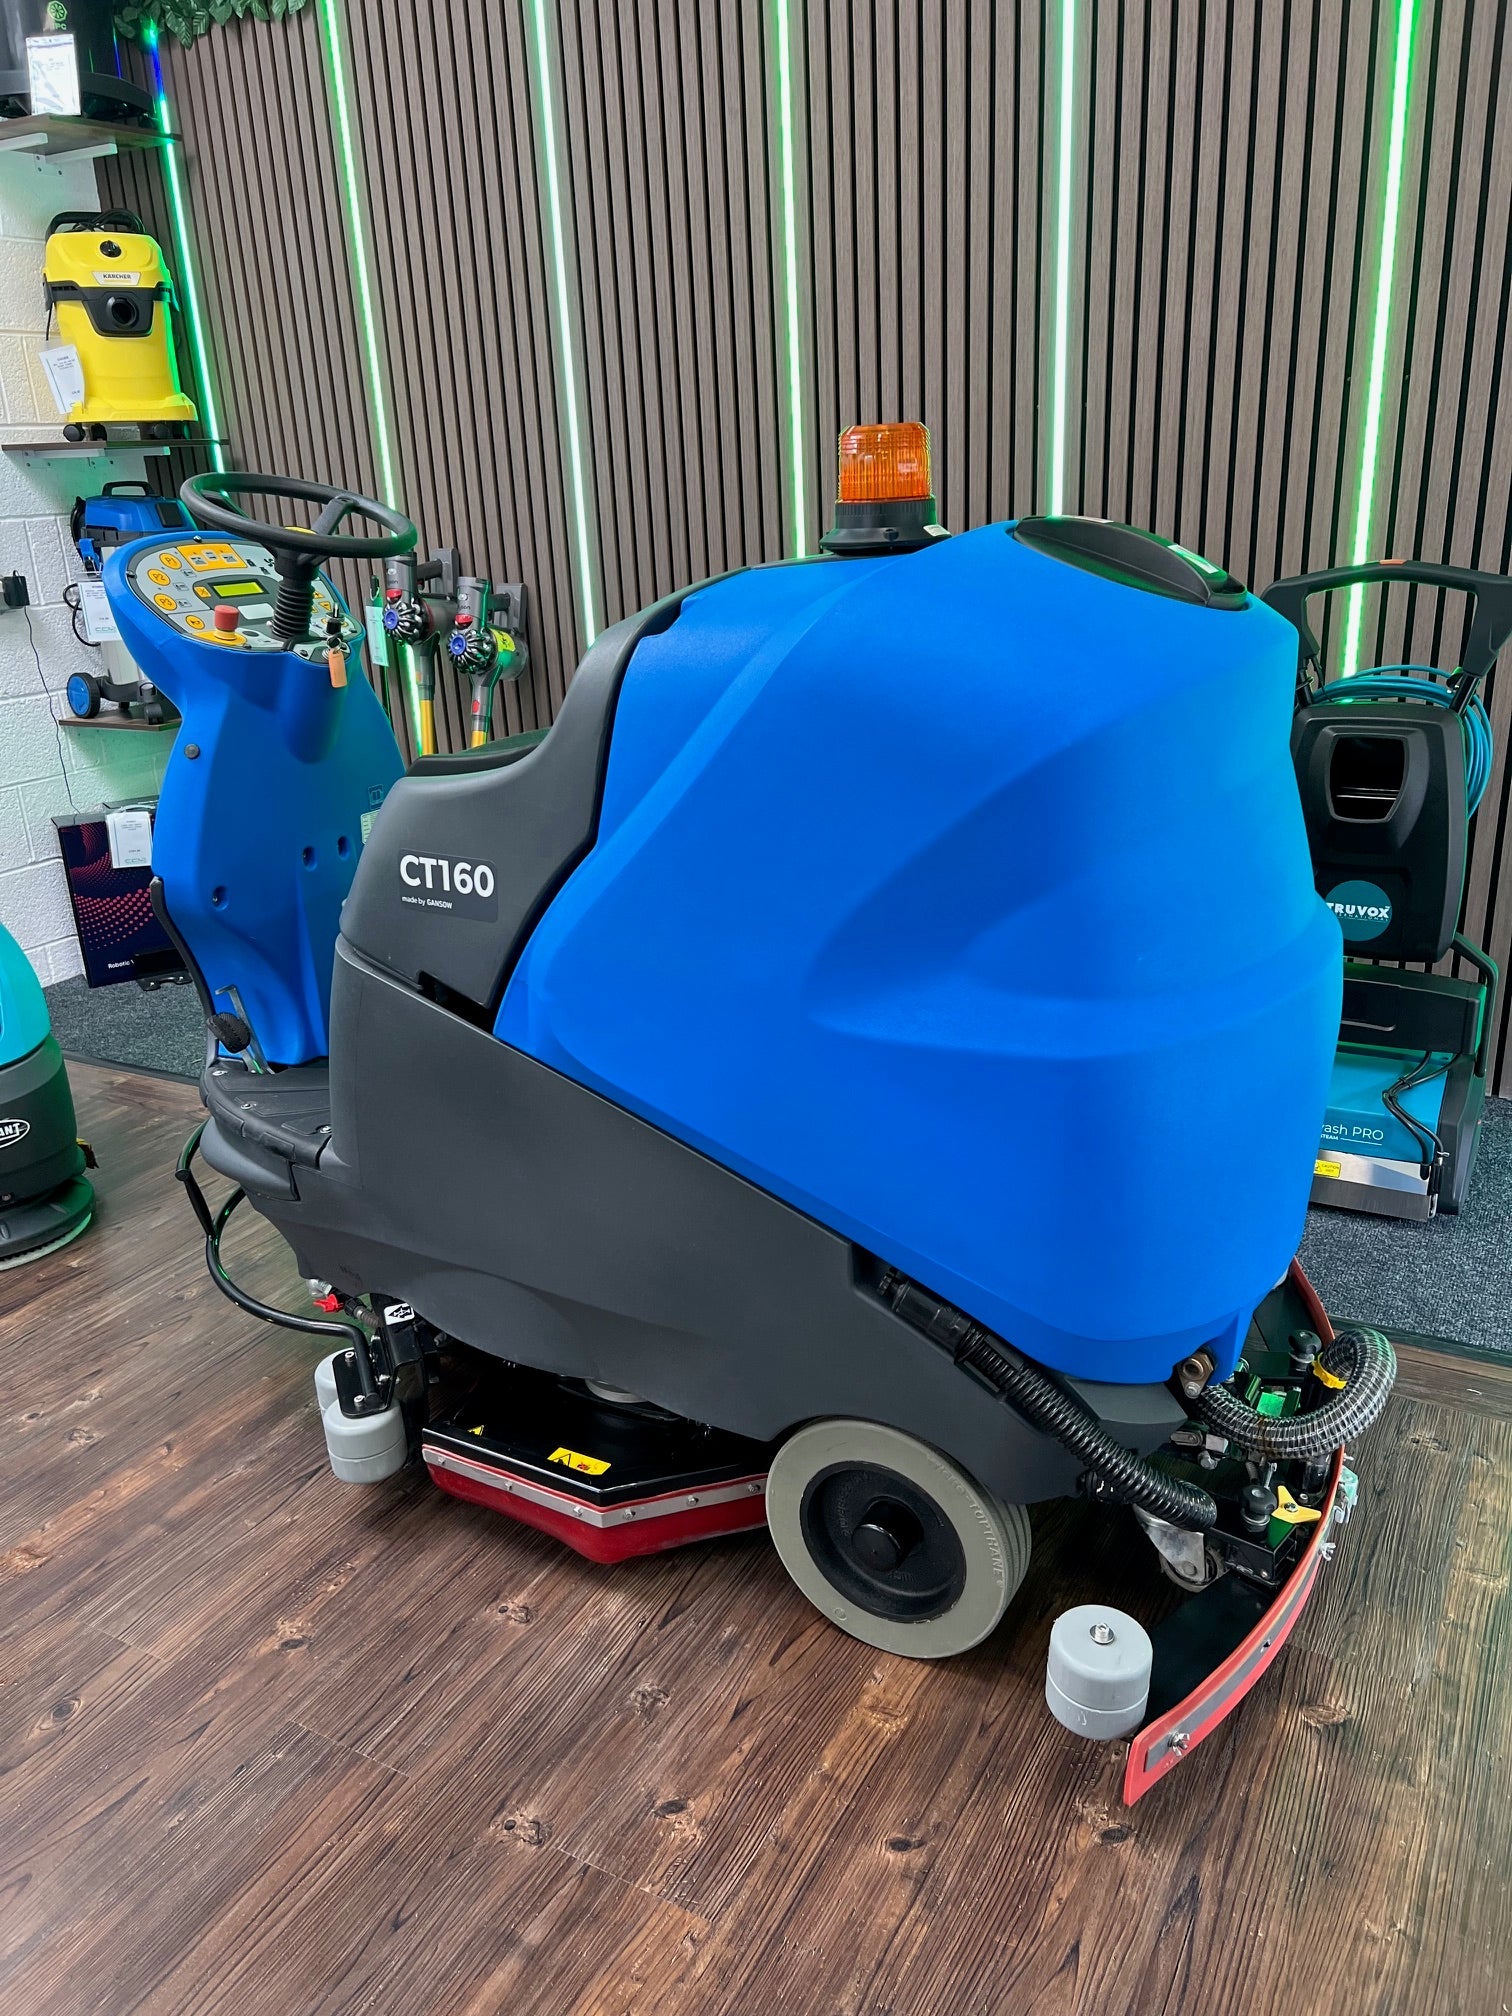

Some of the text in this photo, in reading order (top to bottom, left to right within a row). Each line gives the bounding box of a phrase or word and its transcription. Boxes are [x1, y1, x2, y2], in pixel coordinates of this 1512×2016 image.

[400, 854, 495, 898] CT160
[401, 896, 453, 909] made by GANSOW
[107, 960, 131, 969] Robotic
[1352, 1126, 1384, 1141] PRO
